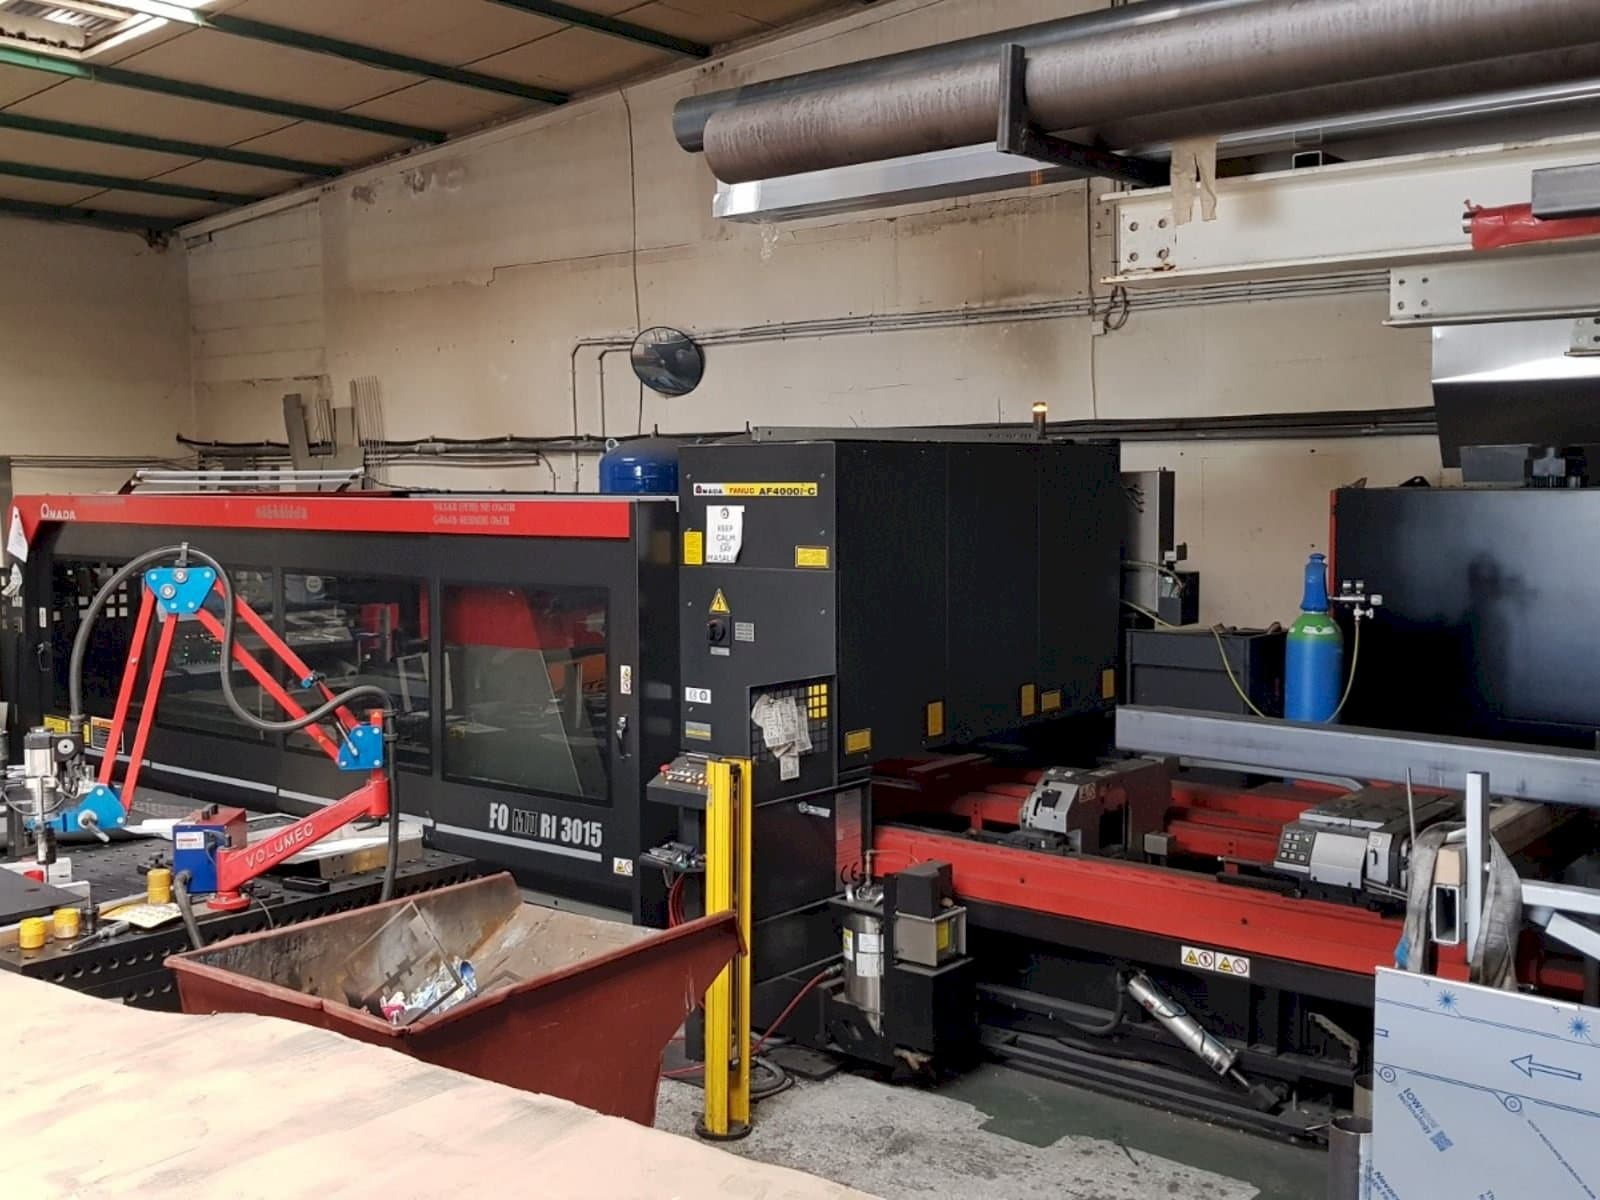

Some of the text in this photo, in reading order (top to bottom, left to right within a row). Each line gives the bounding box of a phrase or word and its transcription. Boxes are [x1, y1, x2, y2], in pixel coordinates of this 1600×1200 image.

[729, 487, 755, 495] FANUC
[717, 524, 734, 532] KEEP
[716, 534, 736, 542] CALM
[489, 802, 510, 831] FO
[540, 813, 557, 840] RI
[560, 816, 603, 848] 3015
[246, 822, 314, 868] VOLUMEC
